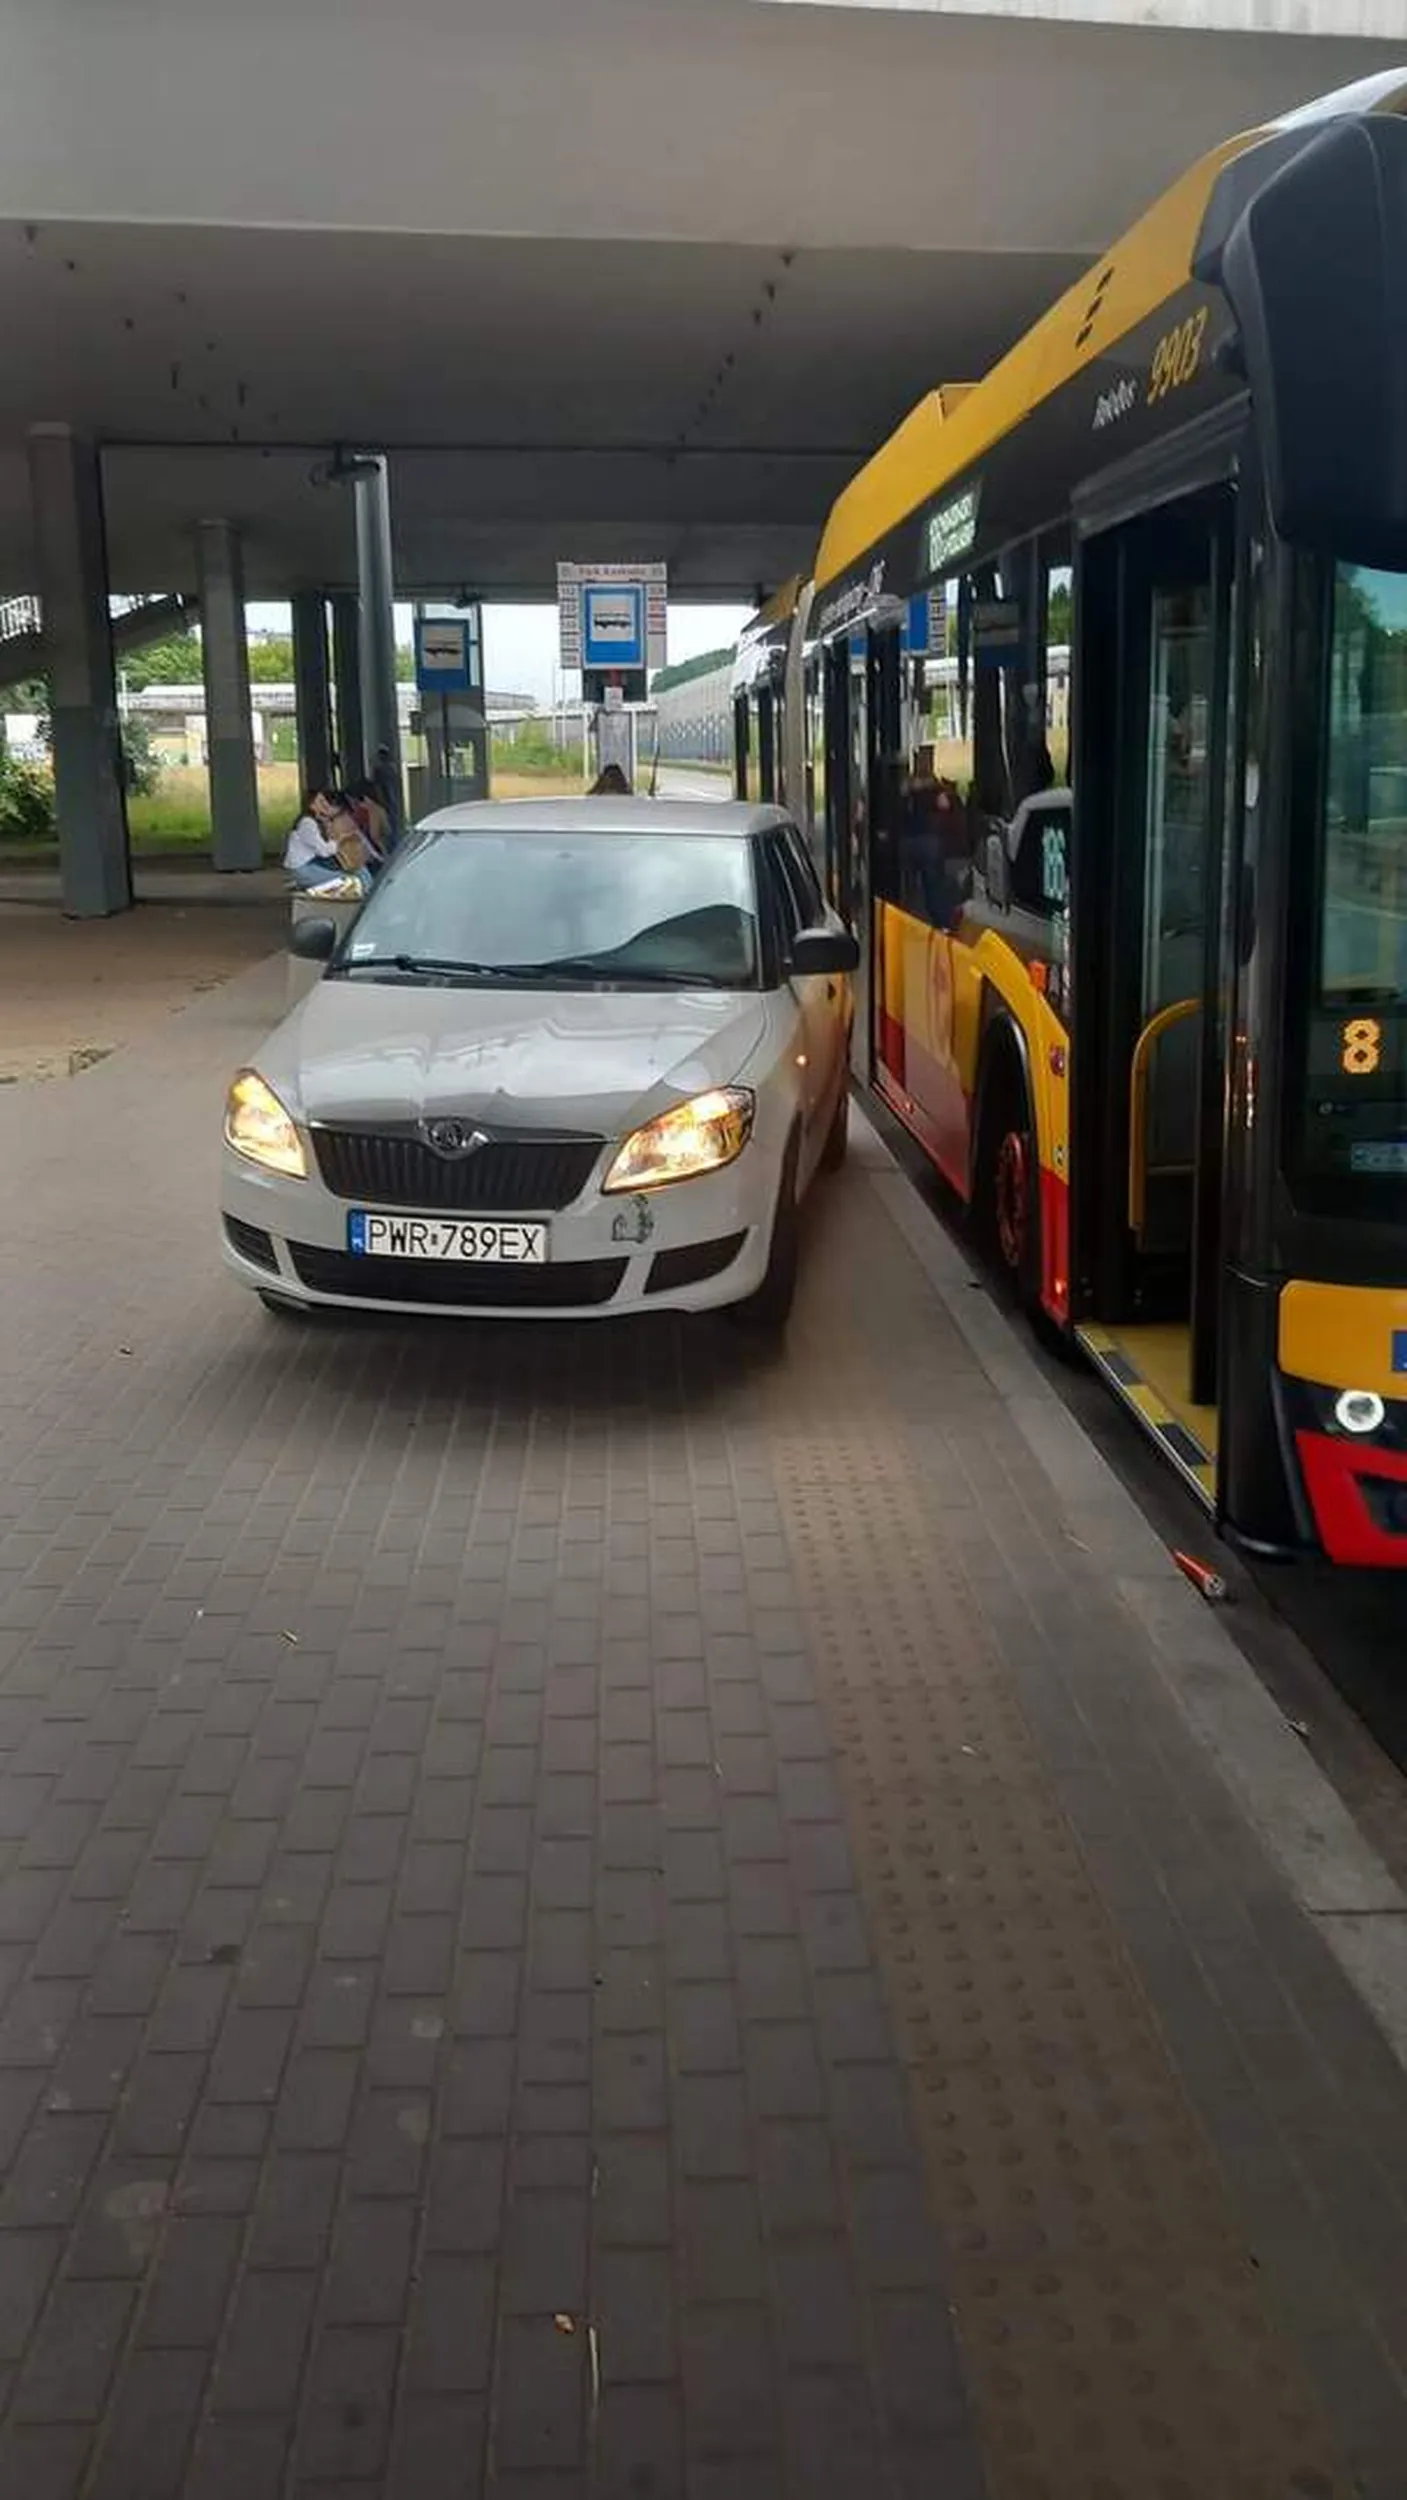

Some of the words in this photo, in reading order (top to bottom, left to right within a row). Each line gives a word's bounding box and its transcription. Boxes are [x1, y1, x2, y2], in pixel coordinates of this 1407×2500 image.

[1146, 304, 1208, 406] 9903
[1343, 1019, 1381, 1075] 8
[369, 1219, 428, 1254] PWR
[440, 1224, 540, 1260] 789EX
